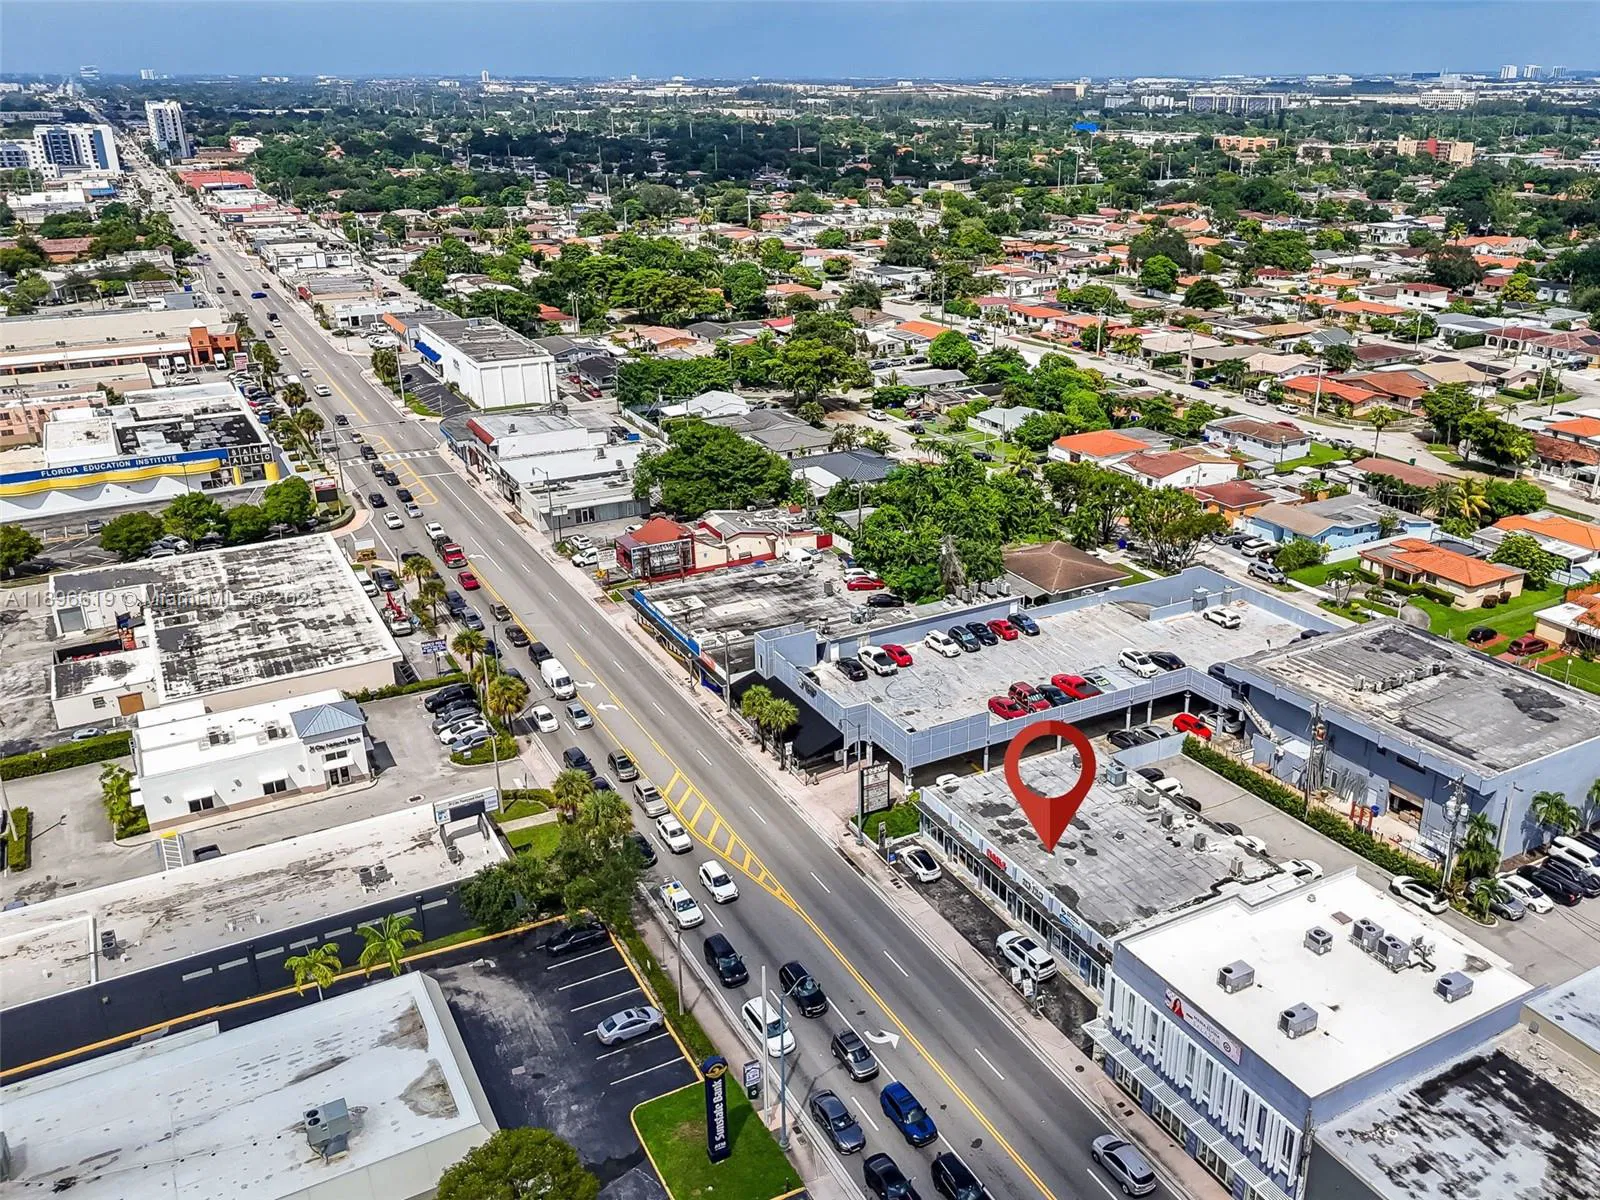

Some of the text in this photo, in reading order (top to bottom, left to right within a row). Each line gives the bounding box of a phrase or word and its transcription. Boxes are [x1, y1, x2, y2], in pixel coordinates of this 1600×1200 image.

[41, 454, 178, 478] FLORIDA EDUCATION INSTITUTE
[712, 1079, 725, 1141] Sunstate Bank
